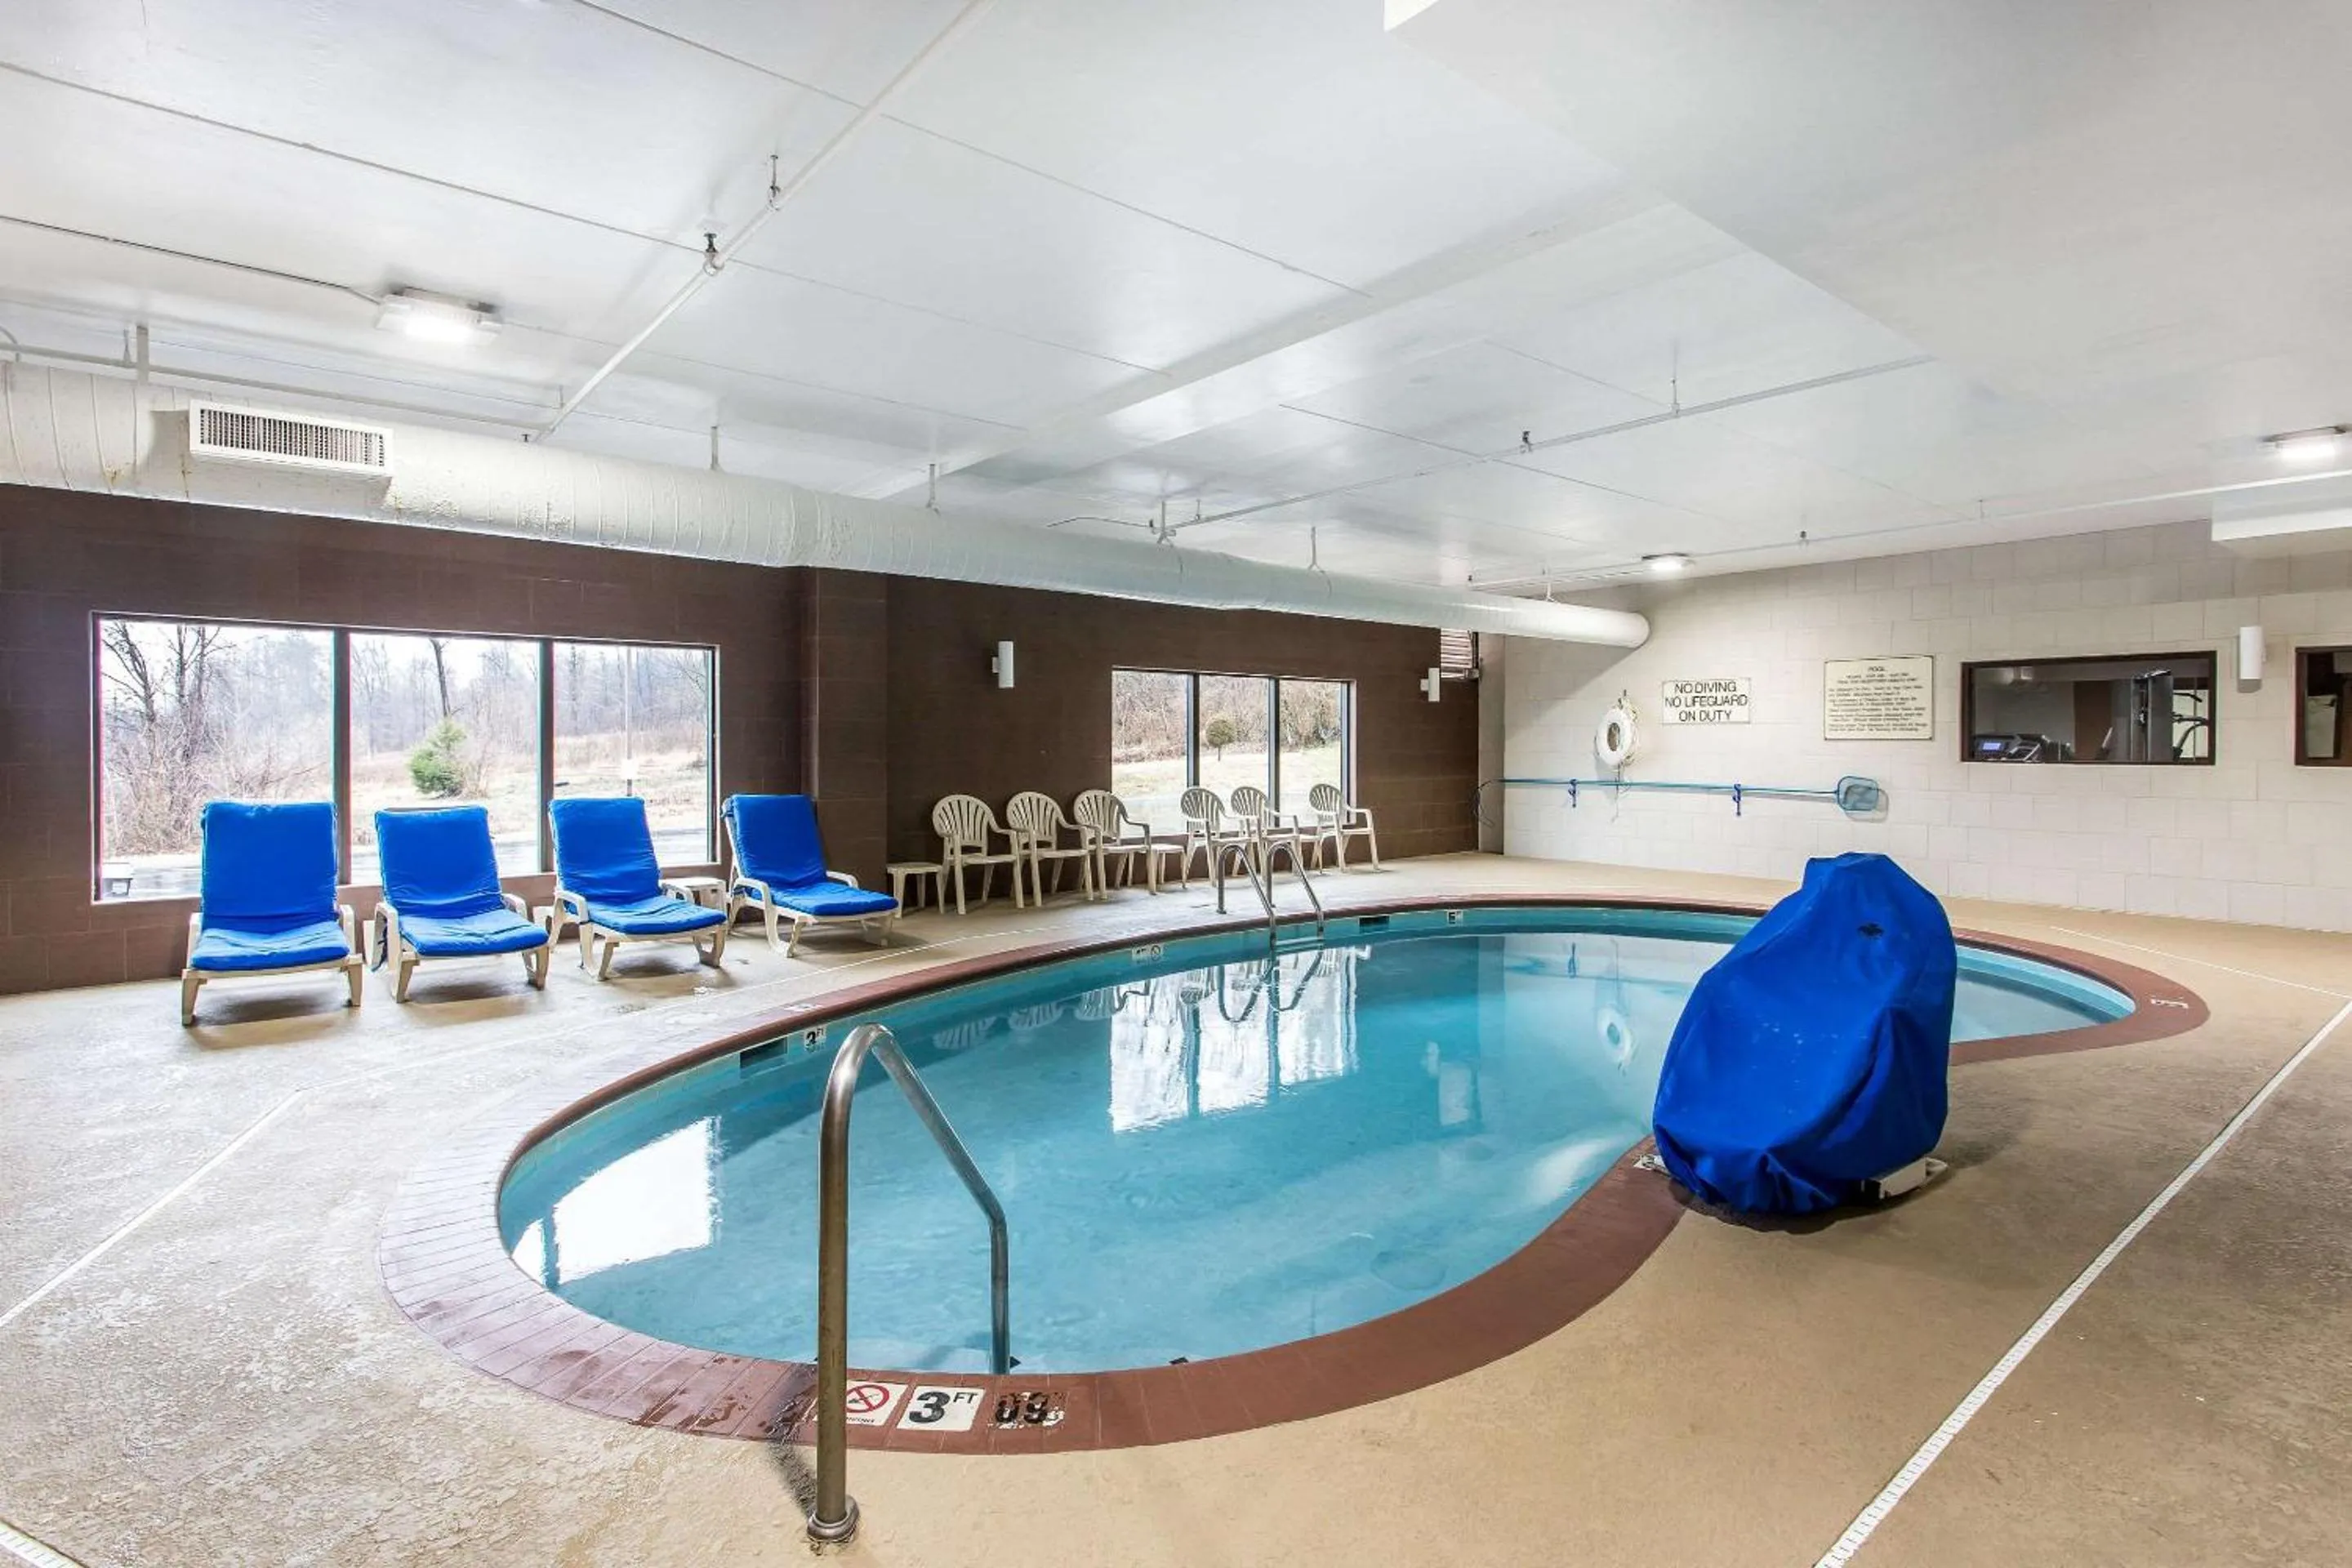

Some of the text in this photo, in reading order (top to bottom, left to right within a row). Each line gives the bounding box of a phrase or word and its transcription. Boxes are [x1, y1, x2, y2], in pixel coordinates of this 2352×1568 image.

[1674, 681, 1737, 693] NO DIVING
[1665, 694, 1748, 708] NO LIFEGUARD
[1679, 710, 1732, 722] ON DUTY
[909, 1392, 978, 1423] 3 FT
